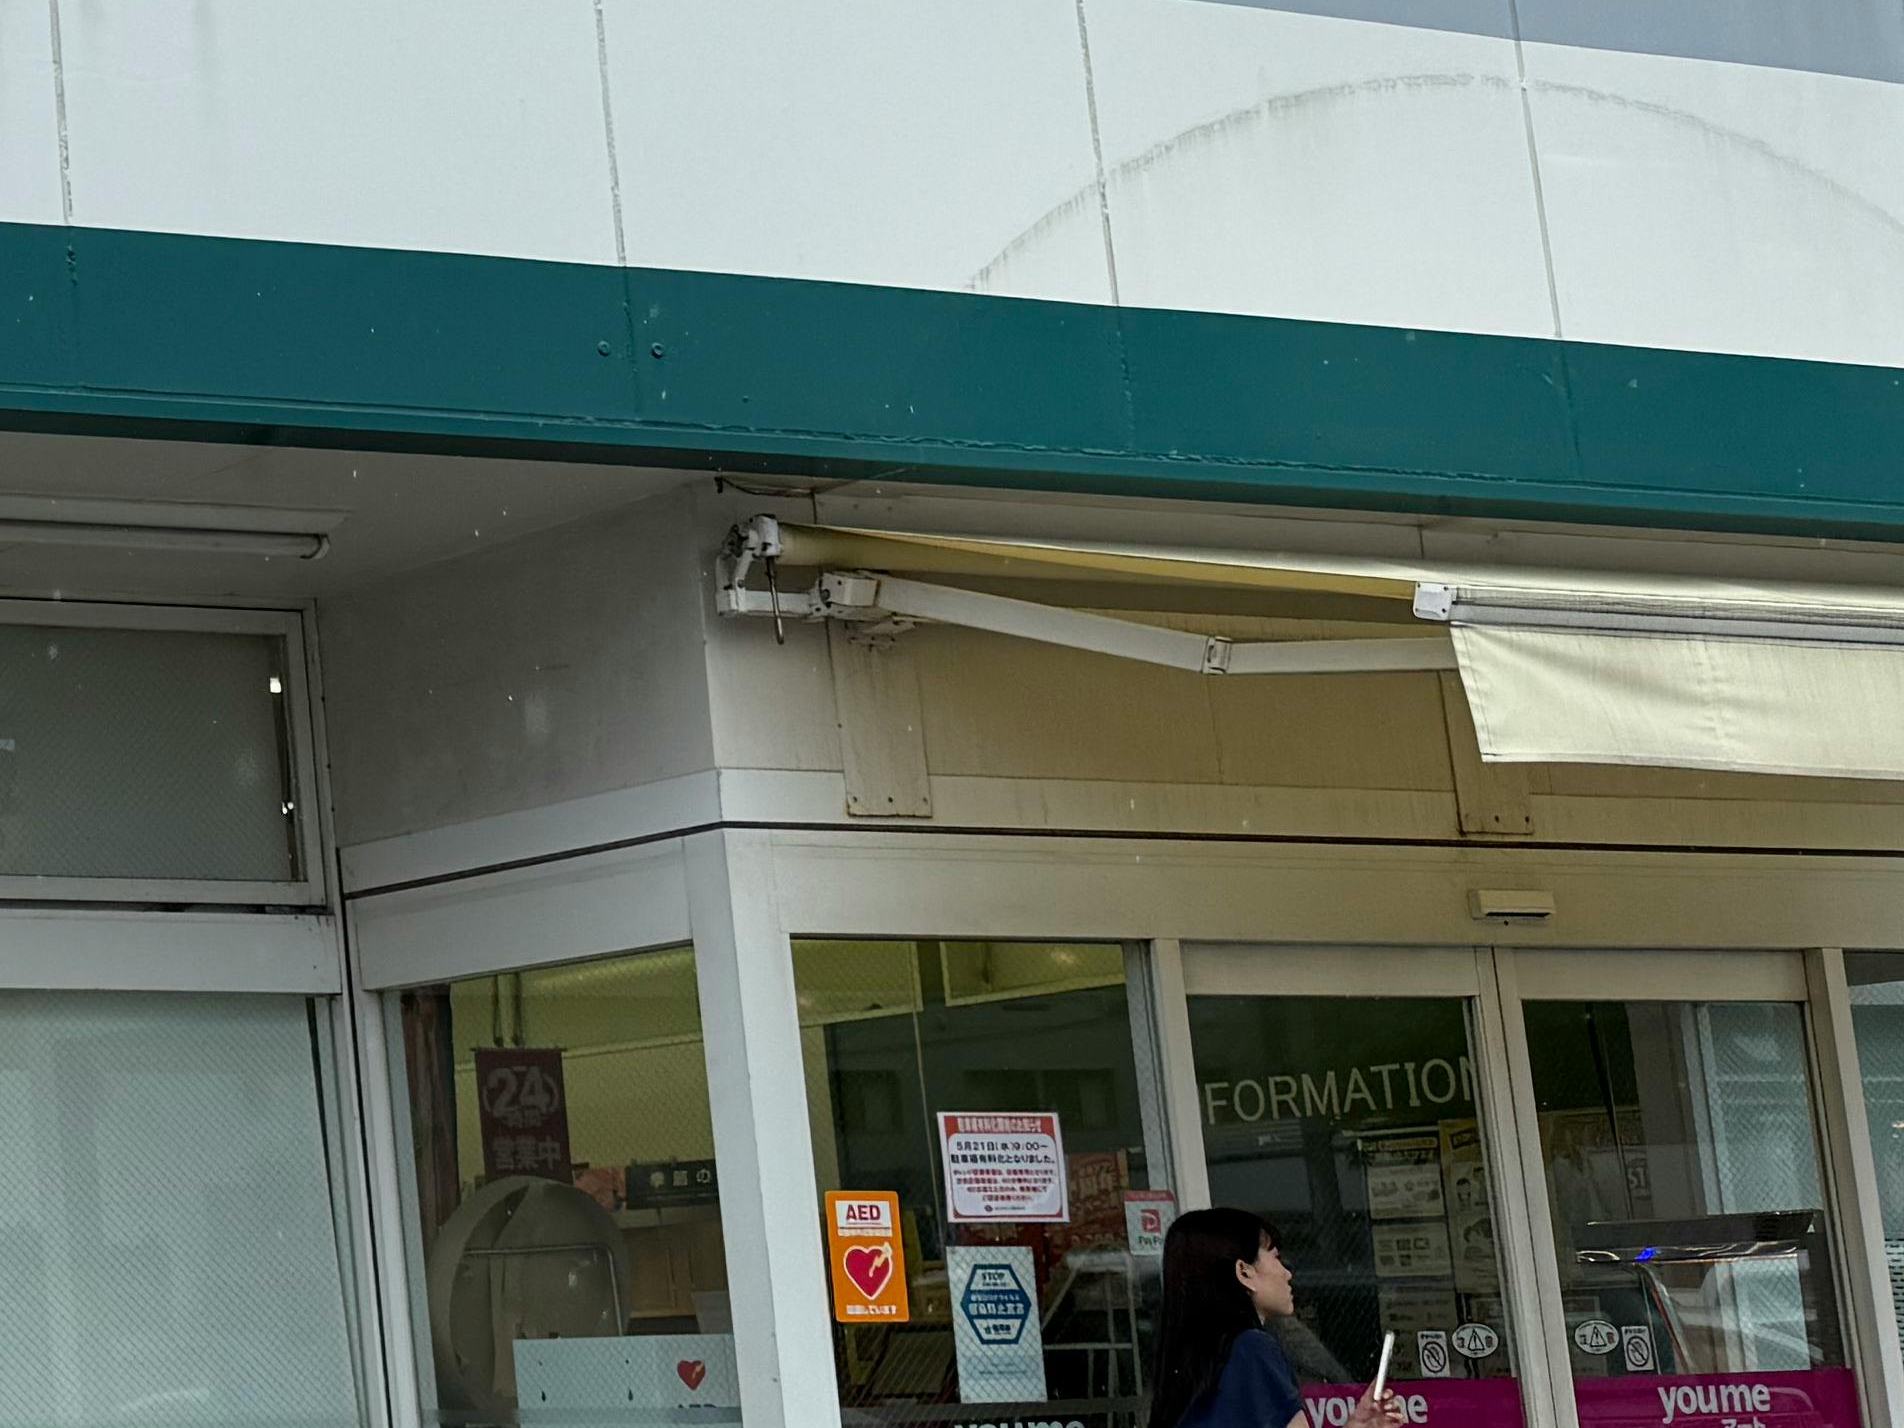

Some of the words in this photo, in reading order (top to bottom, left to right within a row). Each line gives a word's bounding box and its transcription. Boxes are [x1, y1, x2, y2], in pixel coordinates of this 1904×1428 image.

[486, 1065, 554, 1119] 24
[492, 1135, 561, 1171] 営業中
[846, 1204, 881, 1221] AED
[1657, 1383, 1771, 1424] youme
